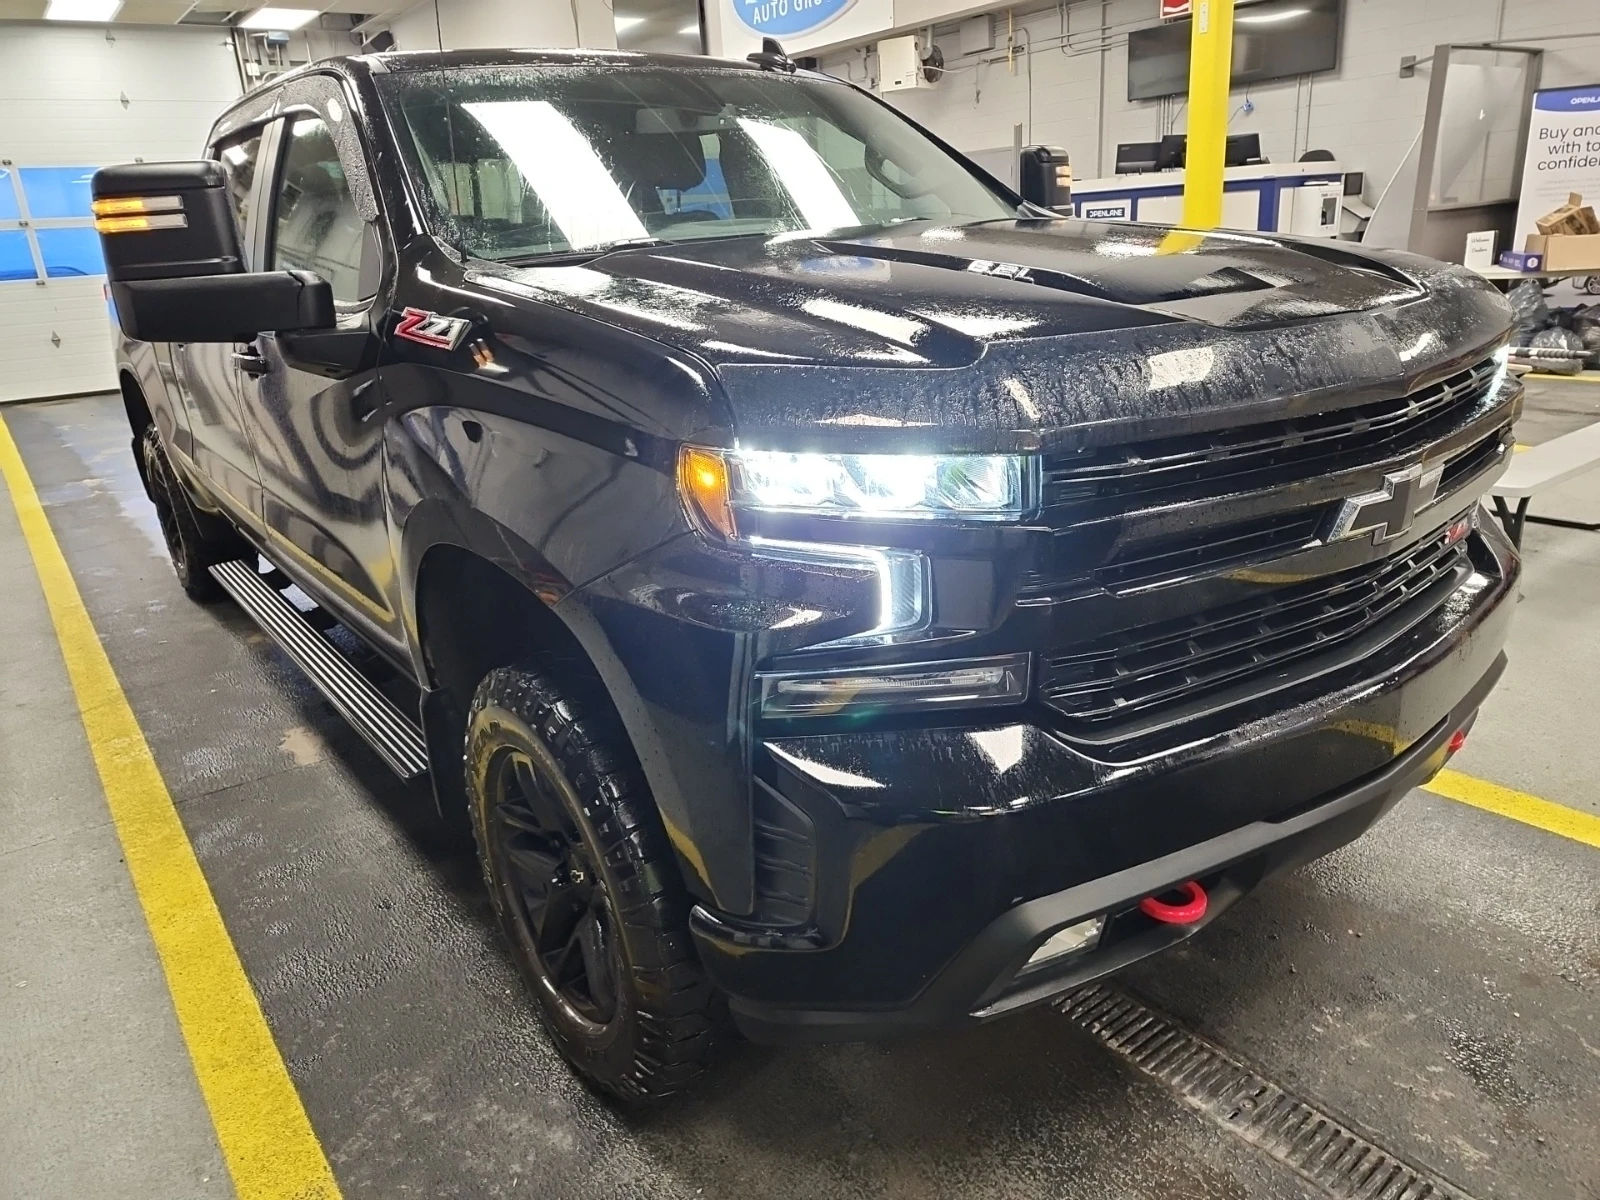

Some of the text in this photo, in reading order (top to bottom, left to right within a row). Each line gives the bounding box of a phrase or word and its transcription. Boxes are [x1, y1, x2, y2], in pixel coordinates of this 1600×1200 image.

[753, 0, 788, 25] AUTO
[1539, 127, 1569, 141] Buy
[1548, 140, 1581, 155] with
[1537, 155, 1600, 171] confide
[394, 306, 472, 351] Z71
